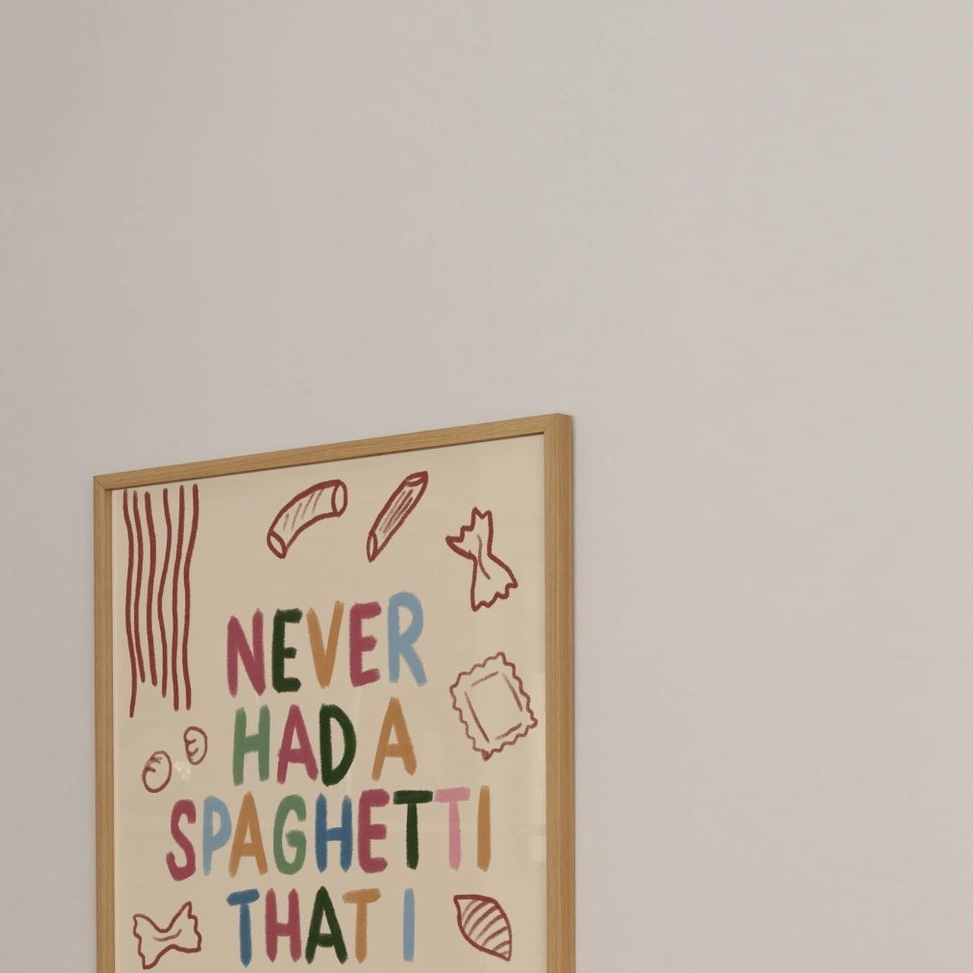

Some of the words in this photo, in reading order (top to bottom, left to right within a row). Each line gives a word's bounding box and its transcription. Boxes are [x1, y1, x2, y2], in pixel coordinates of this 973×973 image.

[226, 591, 427, 698] NEVER
[232, 703, 358, 788] HAD
[371, 697, 418, 781] A
[165, 785, 491, 882] SPAGHETTI
[225, 885, 382, 968] THAT
[402, 888, 416, 962] I
